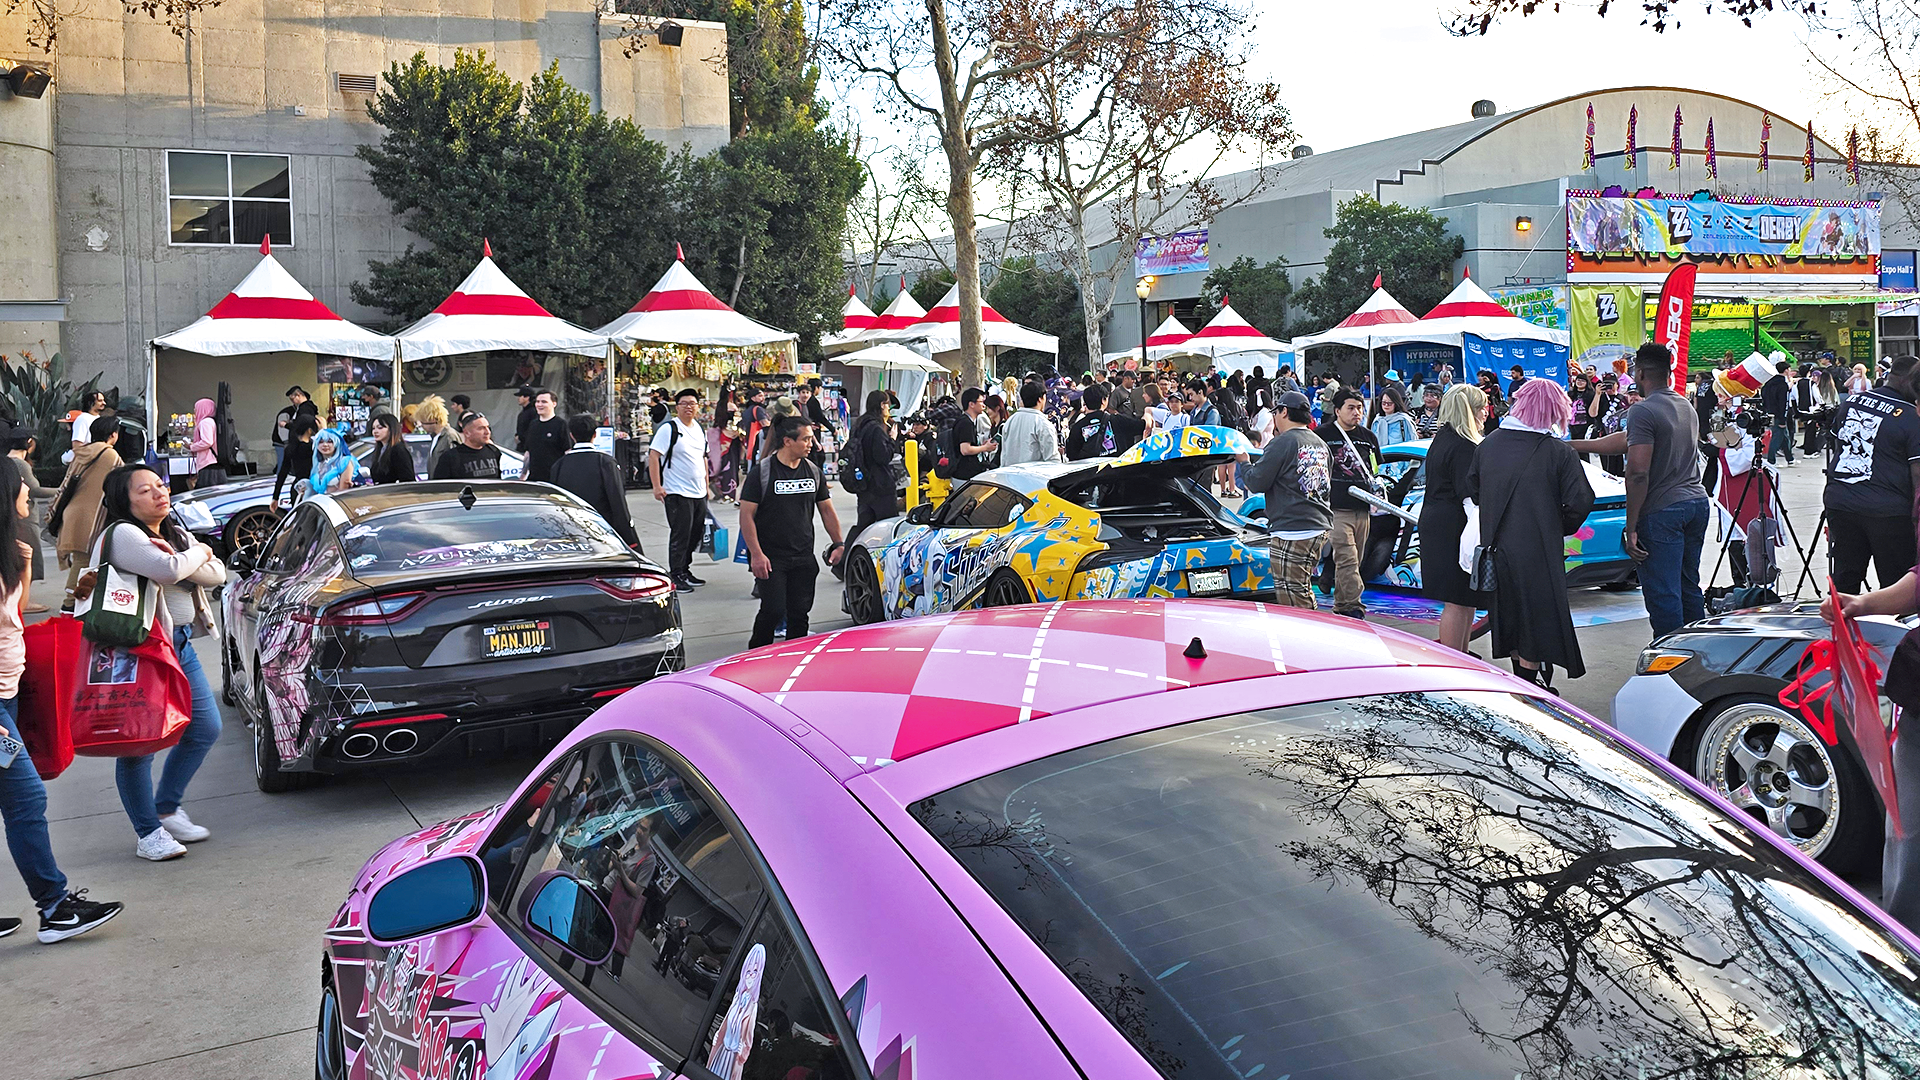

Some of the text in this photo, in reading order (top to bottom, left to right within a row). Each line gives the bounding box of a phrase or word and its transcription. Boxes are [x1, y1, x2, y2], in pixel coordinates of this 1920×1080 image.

[1760, 215, 1802, 242] DERBY
[1881, 266, 1896, 274] Expo
[1897, 266, 1909, 274] Hall
[1496, 289, 1554, 307] WINNER
[1507, 301, 1555, 317] VERY
[1406, 350, 1454, 360] HYDRATION
[1858, 395, 1879, 409] THE
[1876, 401, 1895, 414] BIG
[1892, 408, 1903, 417] 3
[464, 458, 498, 473] MIAMI
[776, 480, 816, 492] sparco
[399, 547, 475, 570] AZUR
[524, 542, 593, 556] LANE
[467, 594, 554, 610] stinger
[497, 622, 537, 632] CALIFORNIA
[494, 643, 544, 657] antisocial af
